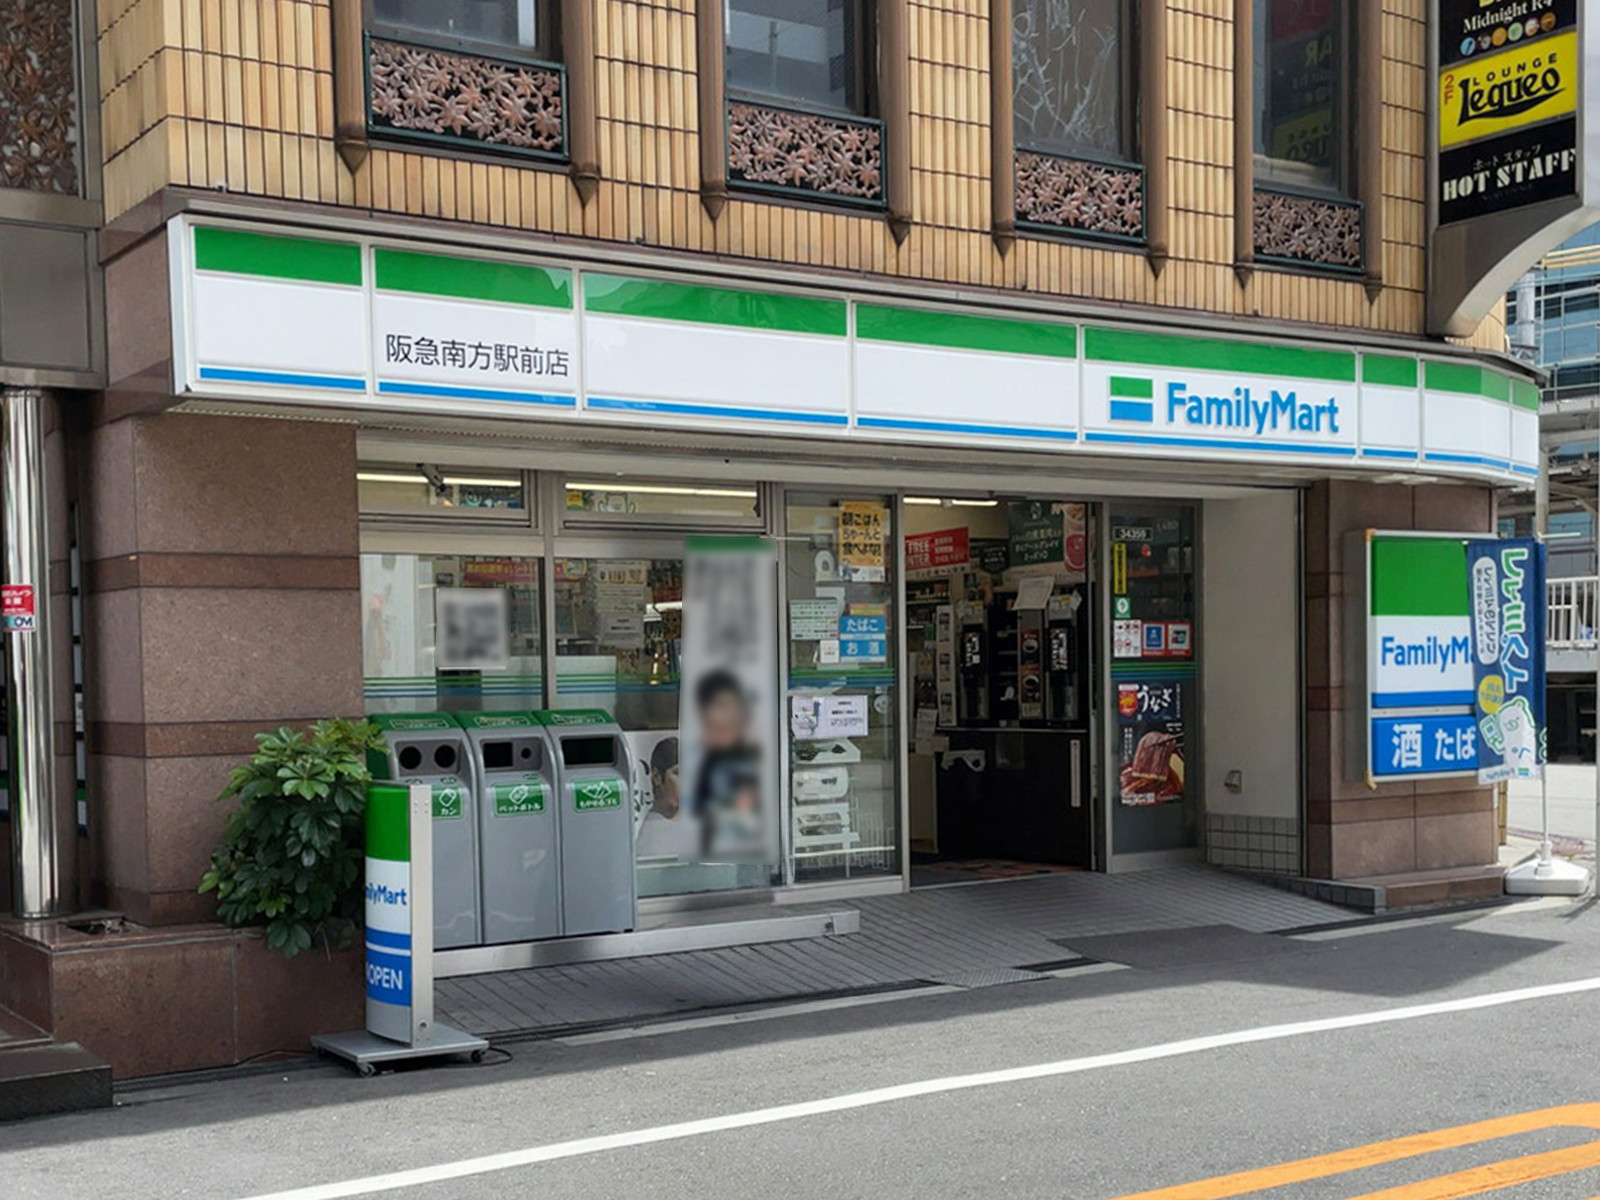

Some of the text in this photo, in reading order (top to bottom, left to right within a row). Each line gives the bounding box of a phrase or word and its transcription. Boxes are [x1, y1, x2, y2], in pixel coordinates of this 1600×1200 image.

[1463, 2, 1528, 33] Midnight
[1473, 53, 1557, 87] LOUNGE
[1442, 148, 1576, 201] HOT STAFF
[386, 334, 569, 377] 阪急南方駅前店
[1167, 382, 1339, 435] FamilyMart
[846, 618, 879, 633] たばこ
[1391, 723, 1423, 769] 酒
[440, 807, 457, 816] カン
